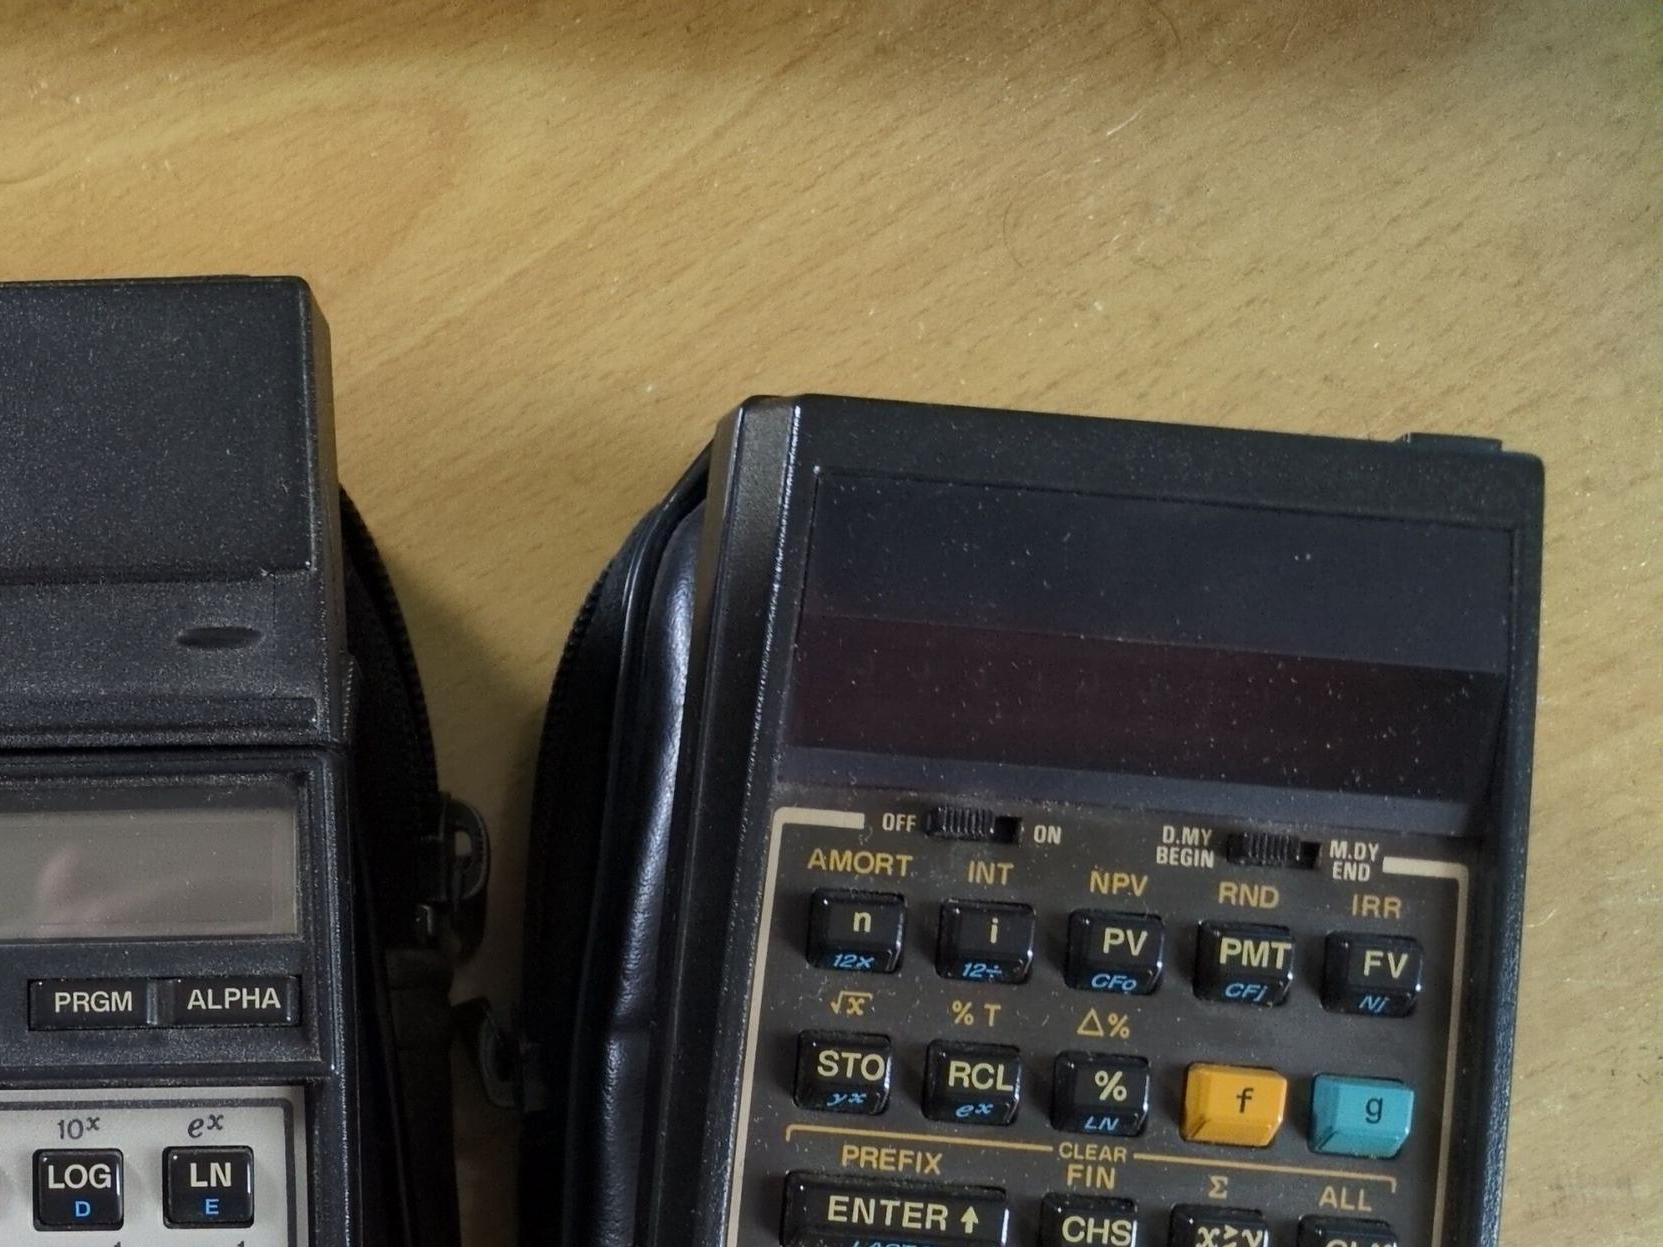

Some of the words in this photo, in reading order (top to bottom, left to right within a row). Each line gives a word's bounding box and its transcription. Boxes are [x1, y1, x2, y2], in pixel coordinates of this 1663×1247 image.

[882, 814, 916, 831] OFF
[1034, 825, 1061, 846] ON
[1163, 826, 1212, 846] D.MY
[807, 848, 913, 877] AMORT
[1156, 846, 1214, 868] BEGIN
[1330, 840, 1379, 862] M.DY
[968, 861, 1014, 885] INT
[1332, 862, 1370, 881] END
[1089, 872, 1148, 897] NPV
[1218, 881, 1279, 909] RND
[1352, 895, 1402, 919] IRR
[853, 912, 871, 932] n
[1103, 928, 1148, 955] PV
[1220, 938, 1291, 970] PMT
[1364, 951, 1408, 979] FV
[54, 990, 133, 1014] PRGM
[187, 988, 280, 1011] ALPHA
[817, 1050, 885, 1081] STO
[948, 1061, 1014, 1091] RCL
[1236, 1088, 1253, 1113] f
[1366, 1098, 1383, 1124] g
[1084, 1116, 1120, 1130] LN
[842, 1145, 943, 1174] PREFIX
[1058, 1142, 1127, 1163] CLEAR
[48, 1164, 111, 1189] LOG
[190, 1162, 232, 1187] LN
[1067, 1165, 1116, 1190] FIN
[1318, 1187, 1372, 1212] ALL
[828, 1196, 948, 1231] ENTER
[1062, 1216, 1132, 1246] CHS
